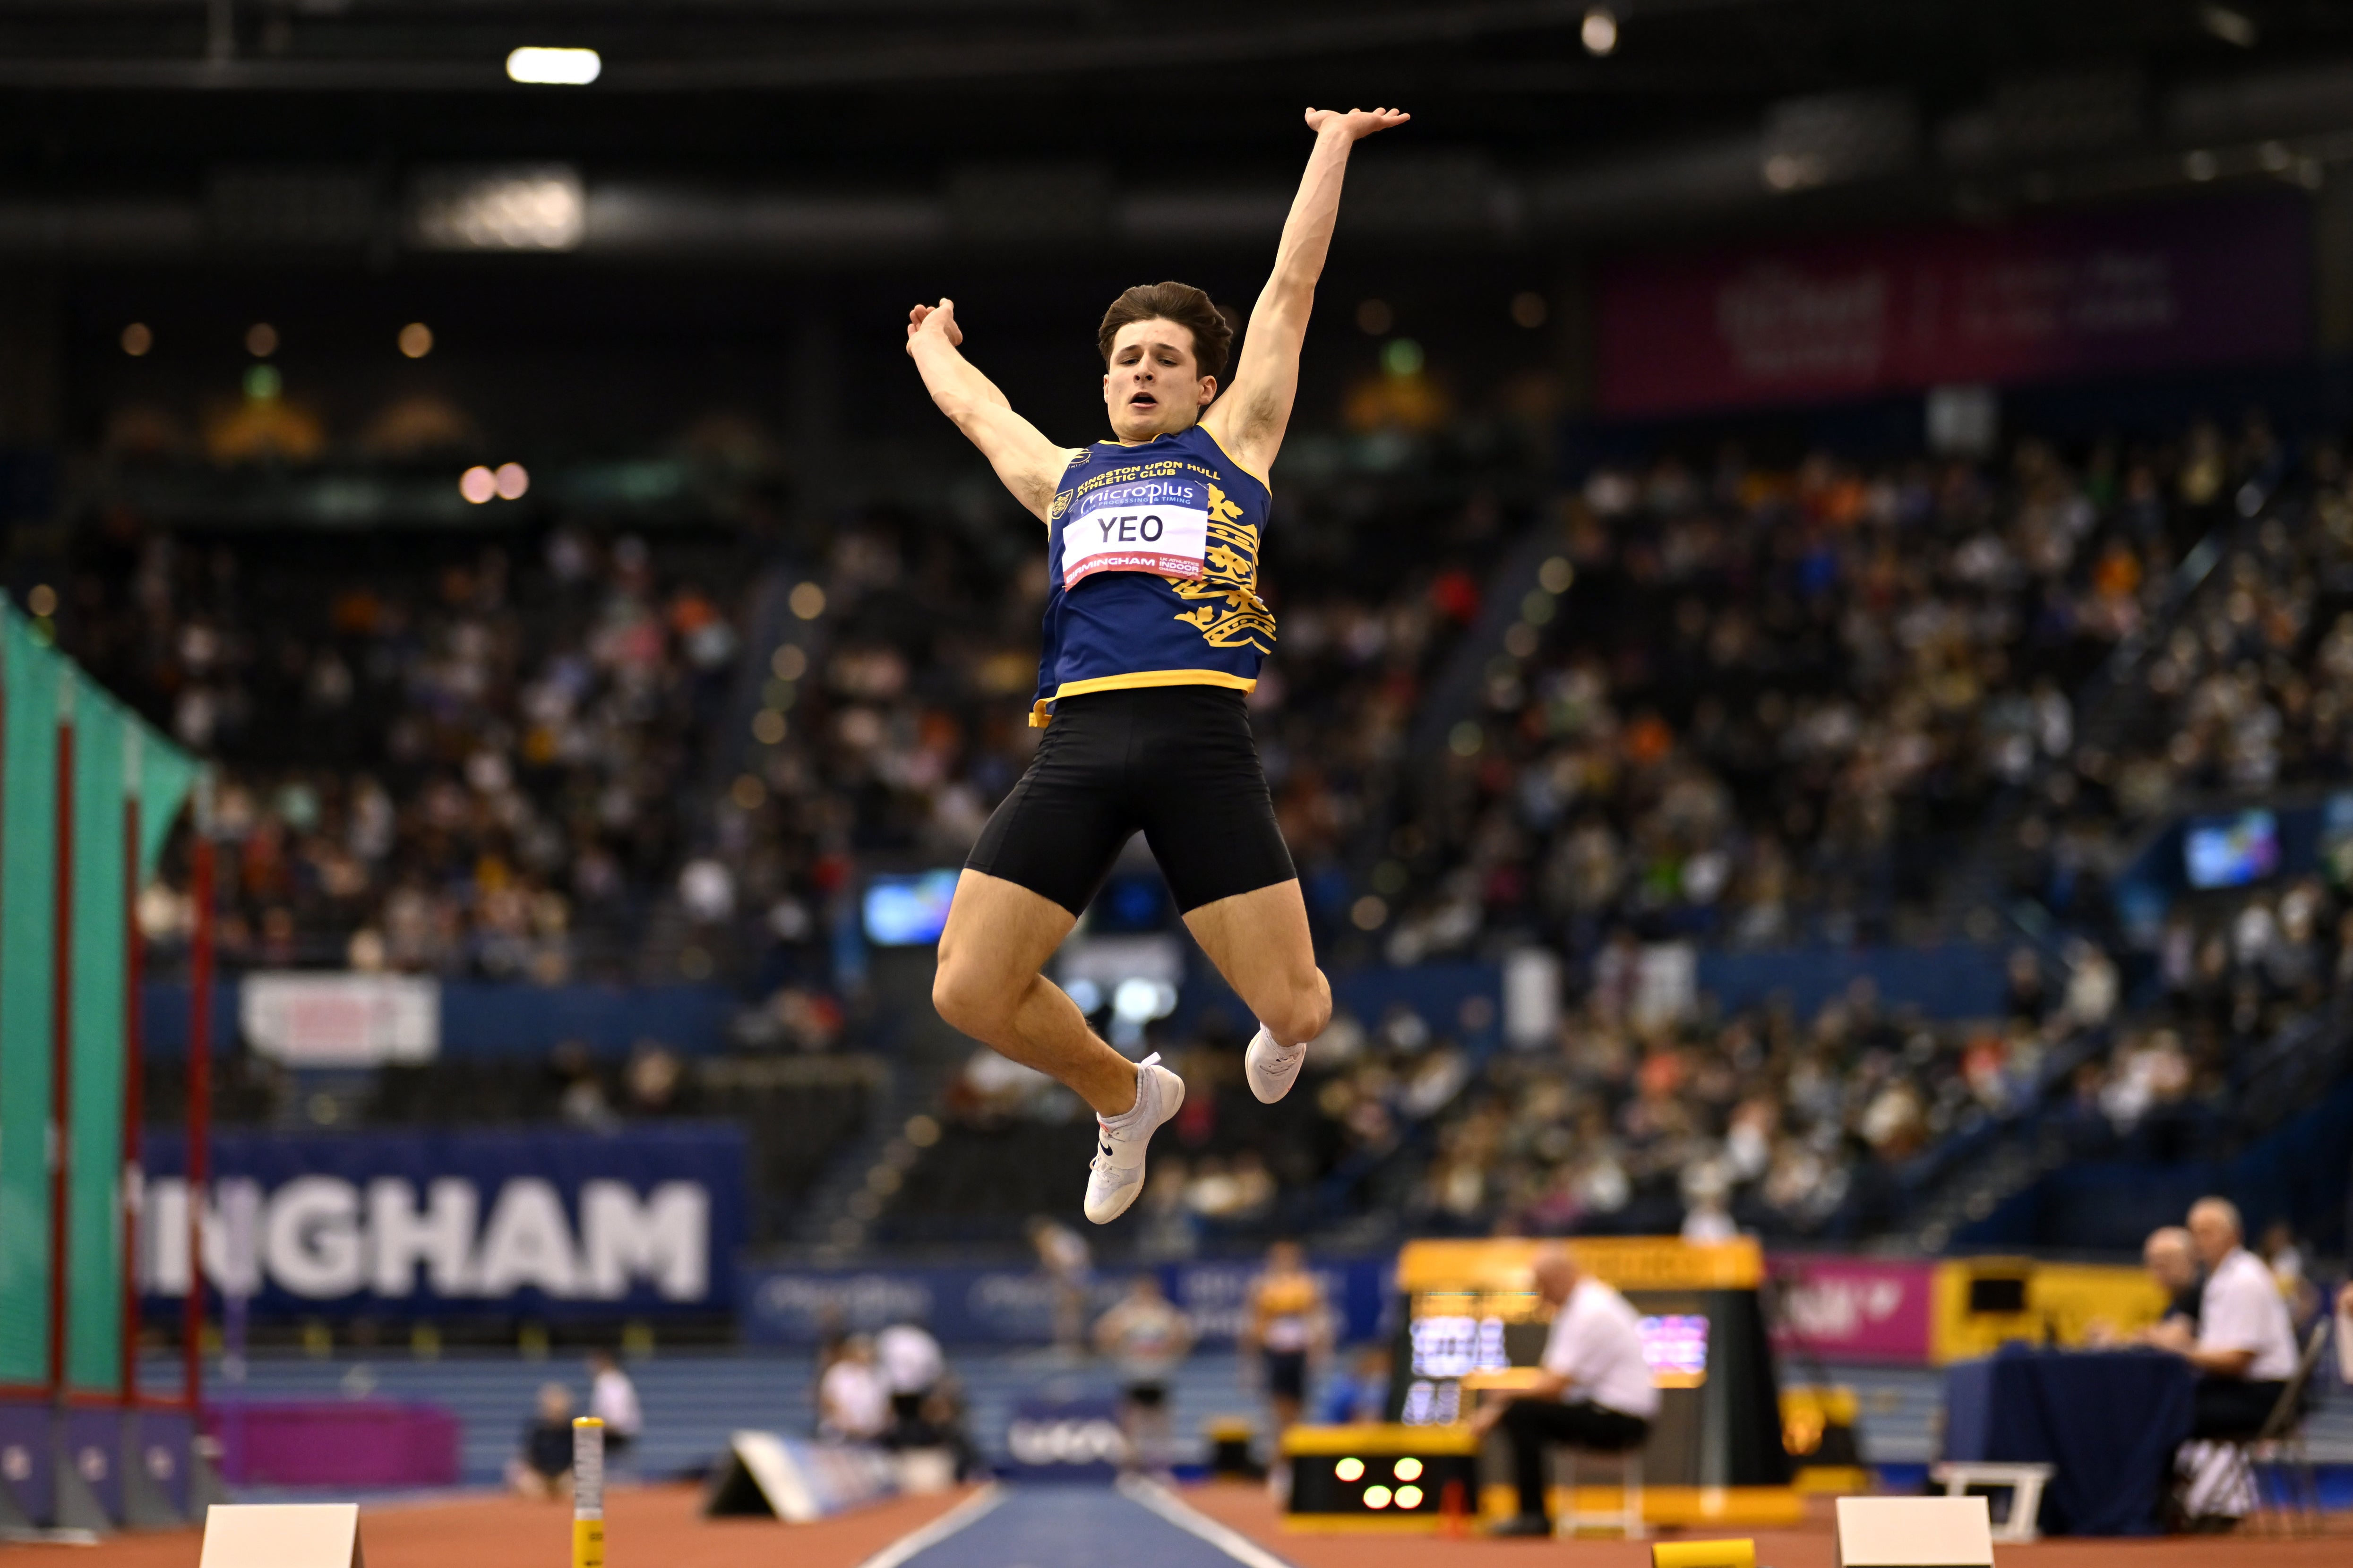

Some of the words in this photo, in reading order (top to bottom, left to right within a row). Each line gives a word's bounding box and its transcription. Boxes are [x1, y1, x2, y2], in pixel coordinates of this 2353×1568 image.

[1076, 473, 1136, 499] ATHLETIC
[1140, 469, 1176, 478] CLUB
[1078, 466, 1141, 492] KINGSTON
[1145, 461, 1183, 470] UPON
[1187, 463, 1221, 480] HULL
[1099, 497, 1149, 506] PROCESSING
[1161, 497, 1191, 505] TIMING
[1097, 515, 1163, 543] YEO
[1066, 557, 1155, 584] BIRMINGHAM
[1159, 561, 1199, 573] INDOOR
[1168, 558, 1199, 566] ATHLETICS
